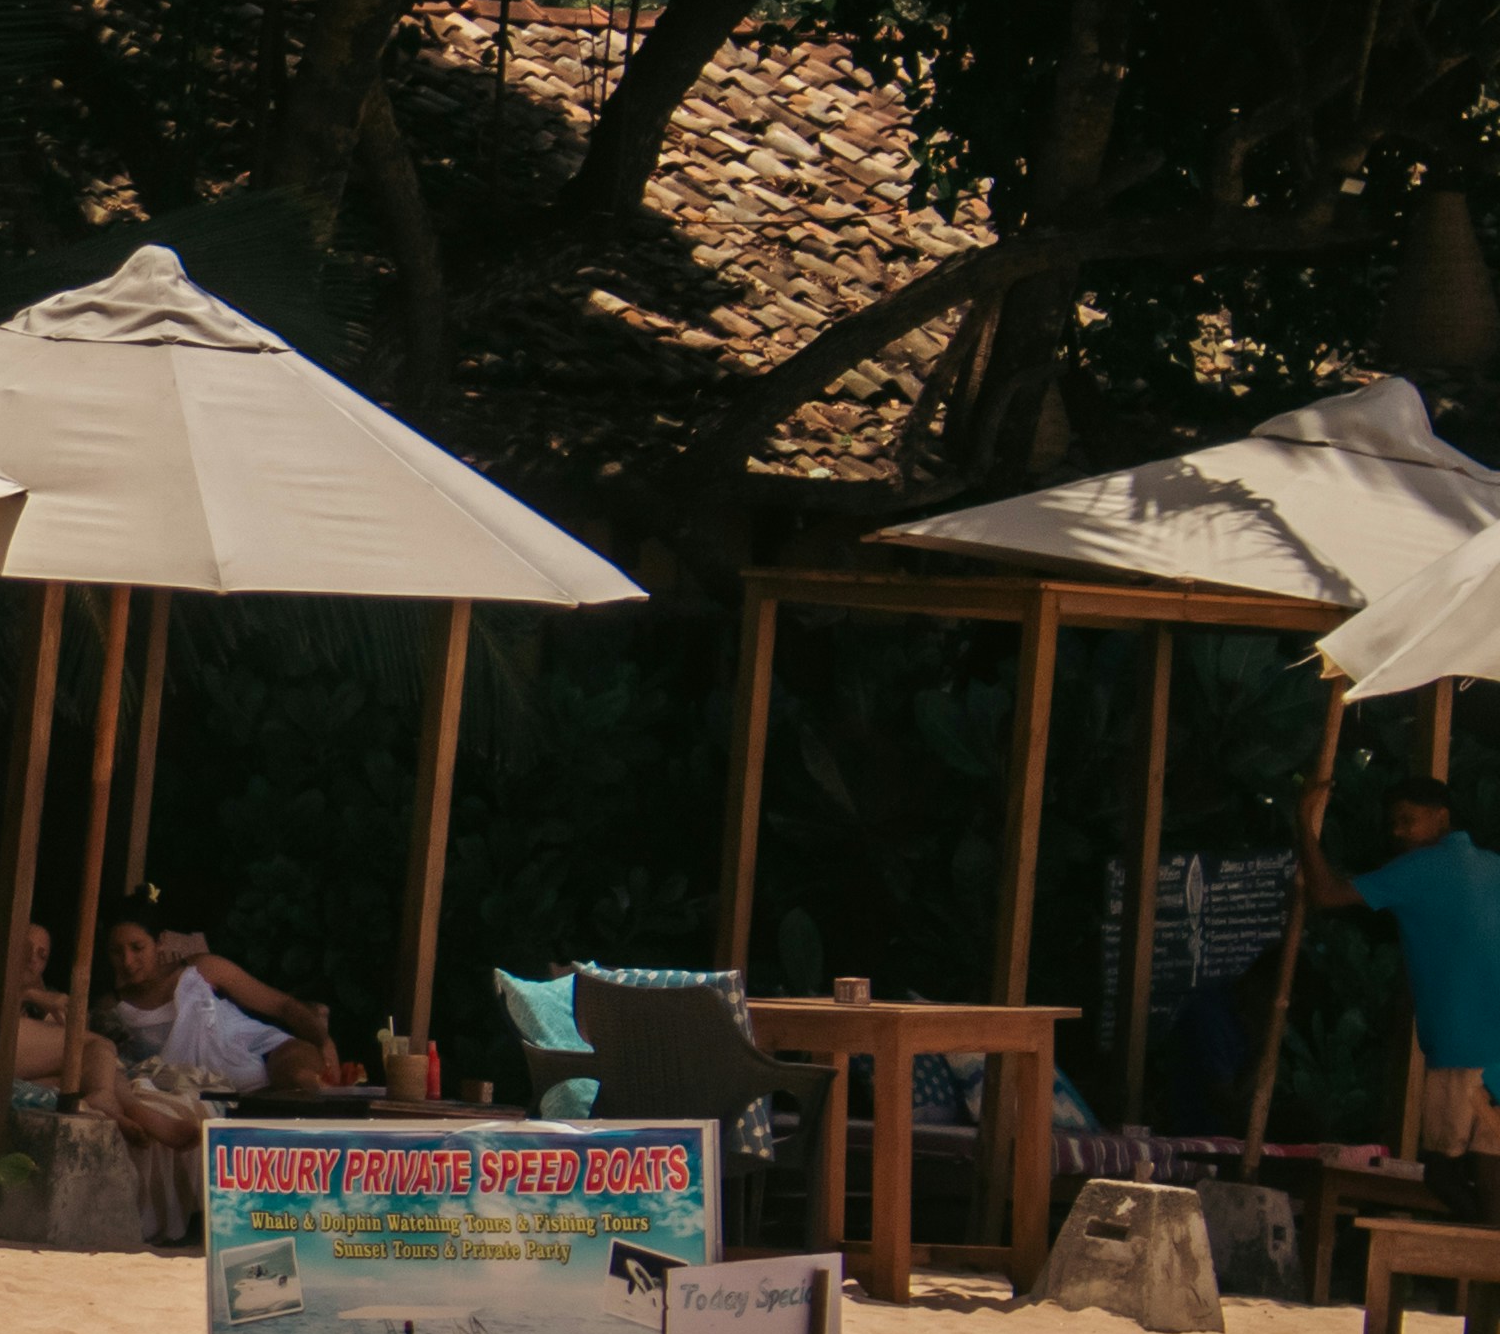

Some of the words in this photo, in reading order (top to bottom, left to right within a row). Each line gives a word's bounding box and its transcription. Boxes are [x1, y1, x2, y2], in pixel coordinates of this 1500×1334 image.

[216, 1145, 340, 1194] LUXURY
[343, 1148, 471, 1195] PRIVATE
[479, 1149, 580, 1195] SPEED
[583, 1144, 690, 1195] BOATS
[251, 1212, 298, 1231] Whale
[303, 1212, 315, 1231] &
[321, 1212, 382, 1236] Dolphin
[387, 1213, 460, 1236] Watching
[465, 1215, 510, 1233] Tours
[516, 1215, 529, 1233] &
[535, 1215, 597, 1237] Fishing
[602, 1213, 649, 1232] Tours
